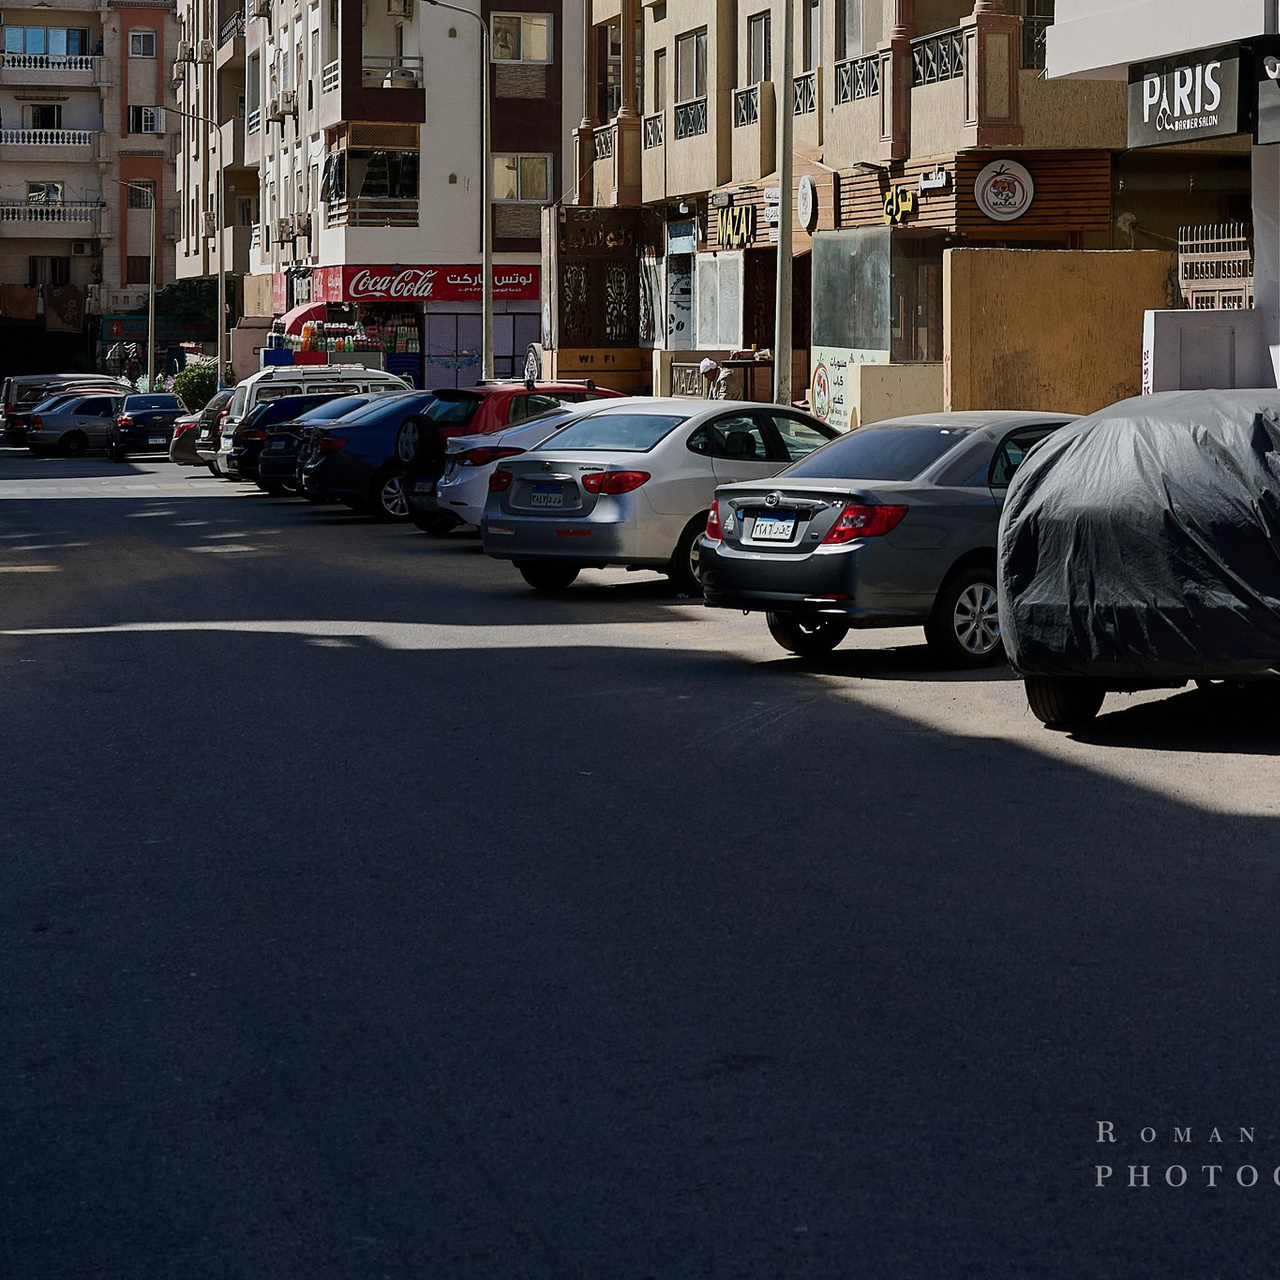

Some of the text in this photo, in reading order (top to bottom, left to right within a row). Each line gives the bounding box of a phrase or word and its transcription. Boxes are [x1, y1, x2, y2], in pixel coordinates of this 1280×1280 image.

[1143, 60, 1221, 126] PARIS
[1198, 115, 1218, 127] SALON
[349, 269, 439, 298] Coca-Cola
[446, 273, 484, 287] اركت
[578, 354, 616, 364] WI FI
